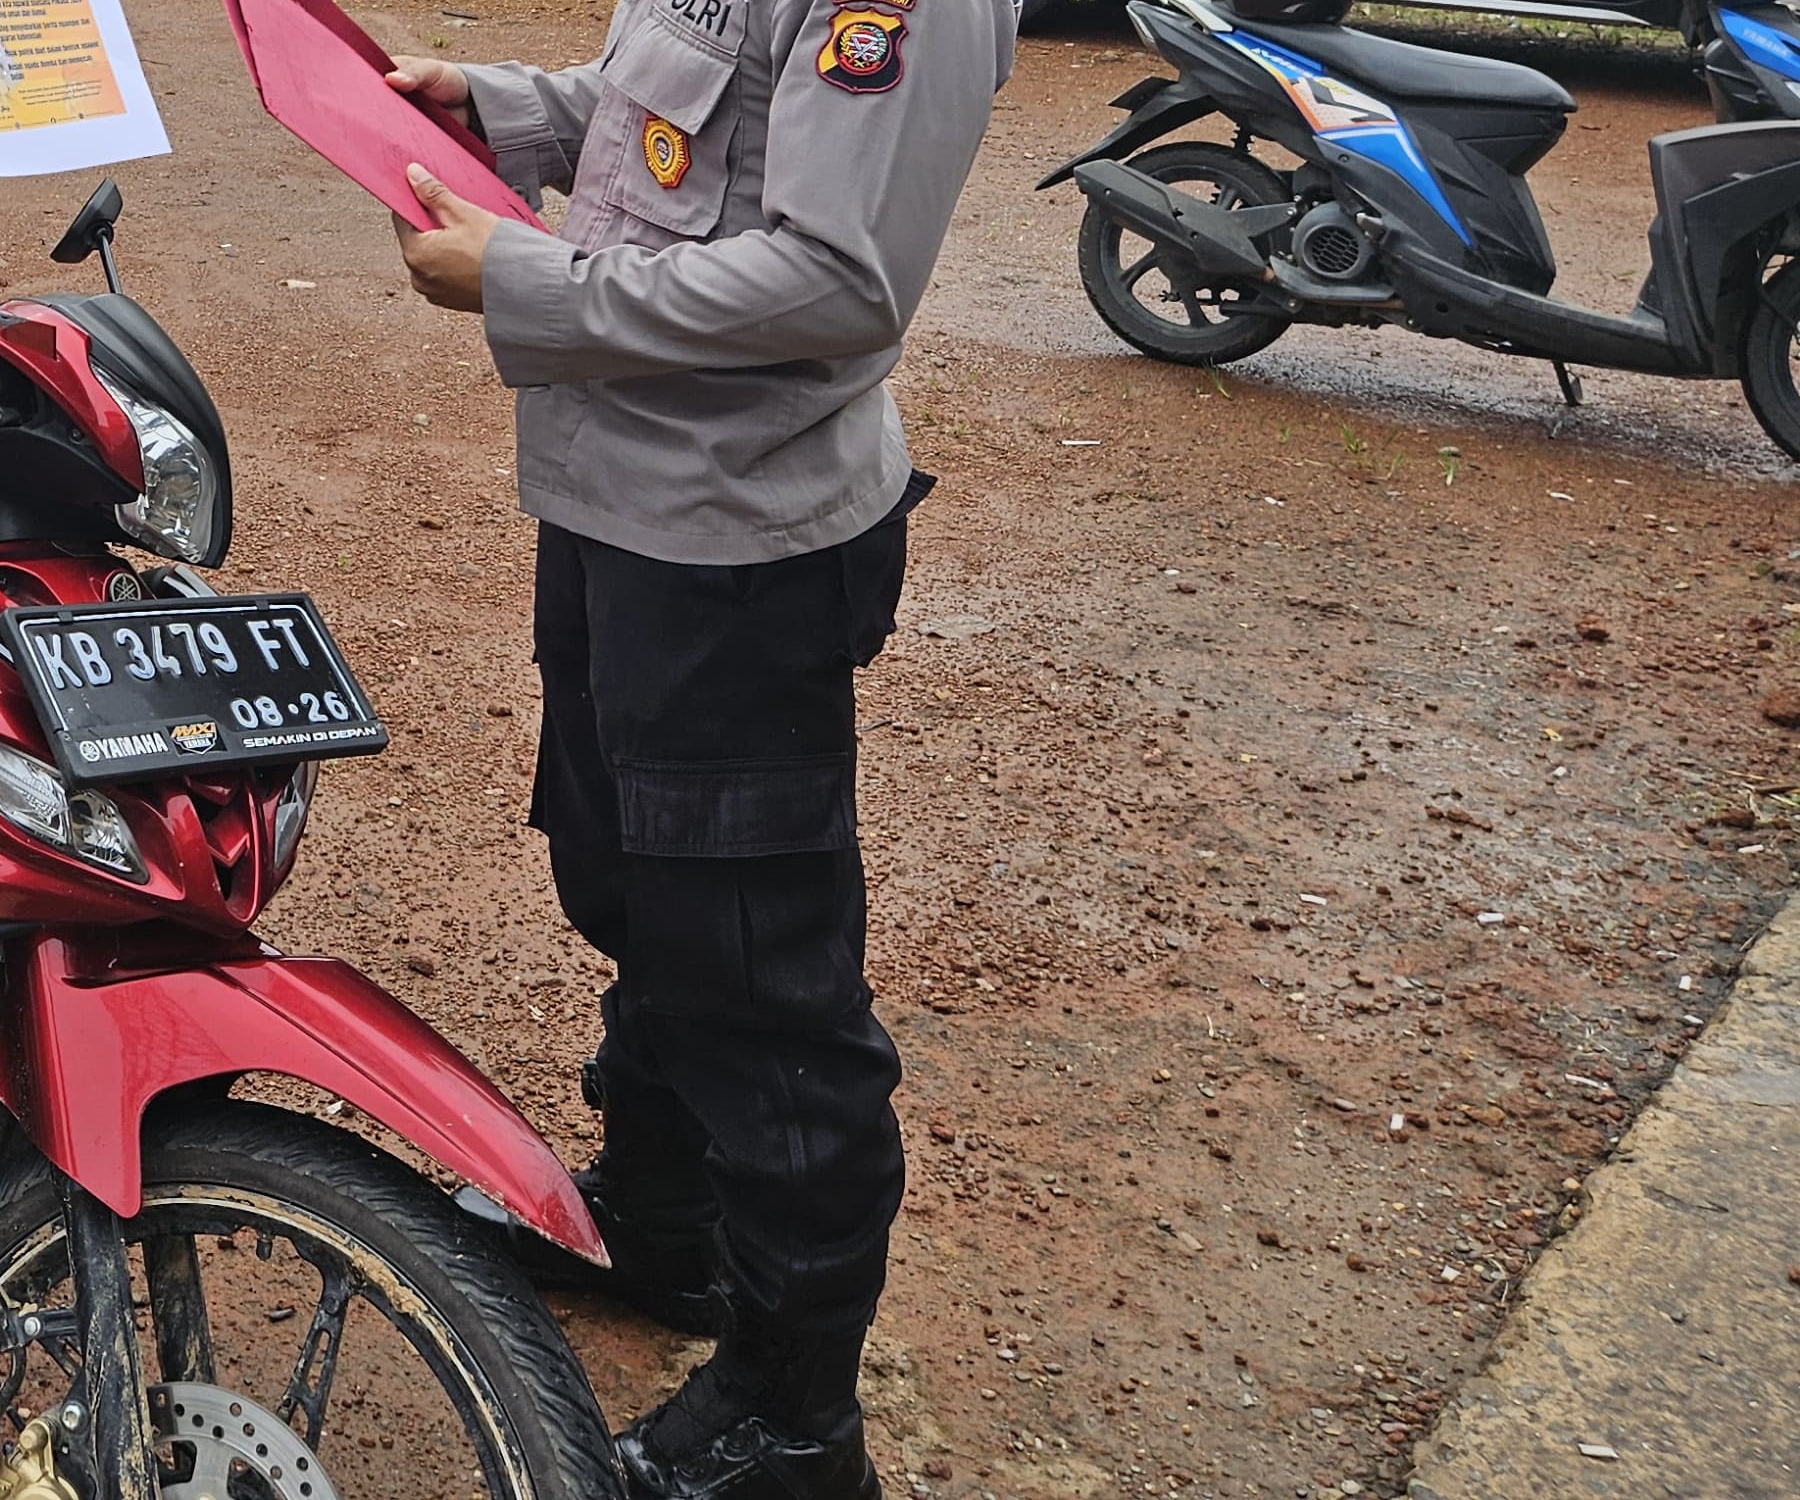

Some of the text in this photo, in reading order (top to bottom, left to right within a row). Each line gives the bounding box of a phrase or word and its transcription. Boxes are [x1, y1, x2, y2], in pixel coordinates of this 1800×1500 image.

[34, 618, 311, 691] KB 3479 FT
[98, 731, 169, 759] YAMAHA
[243, 726, 378, 749] SEMAKIN DI DEPAN
